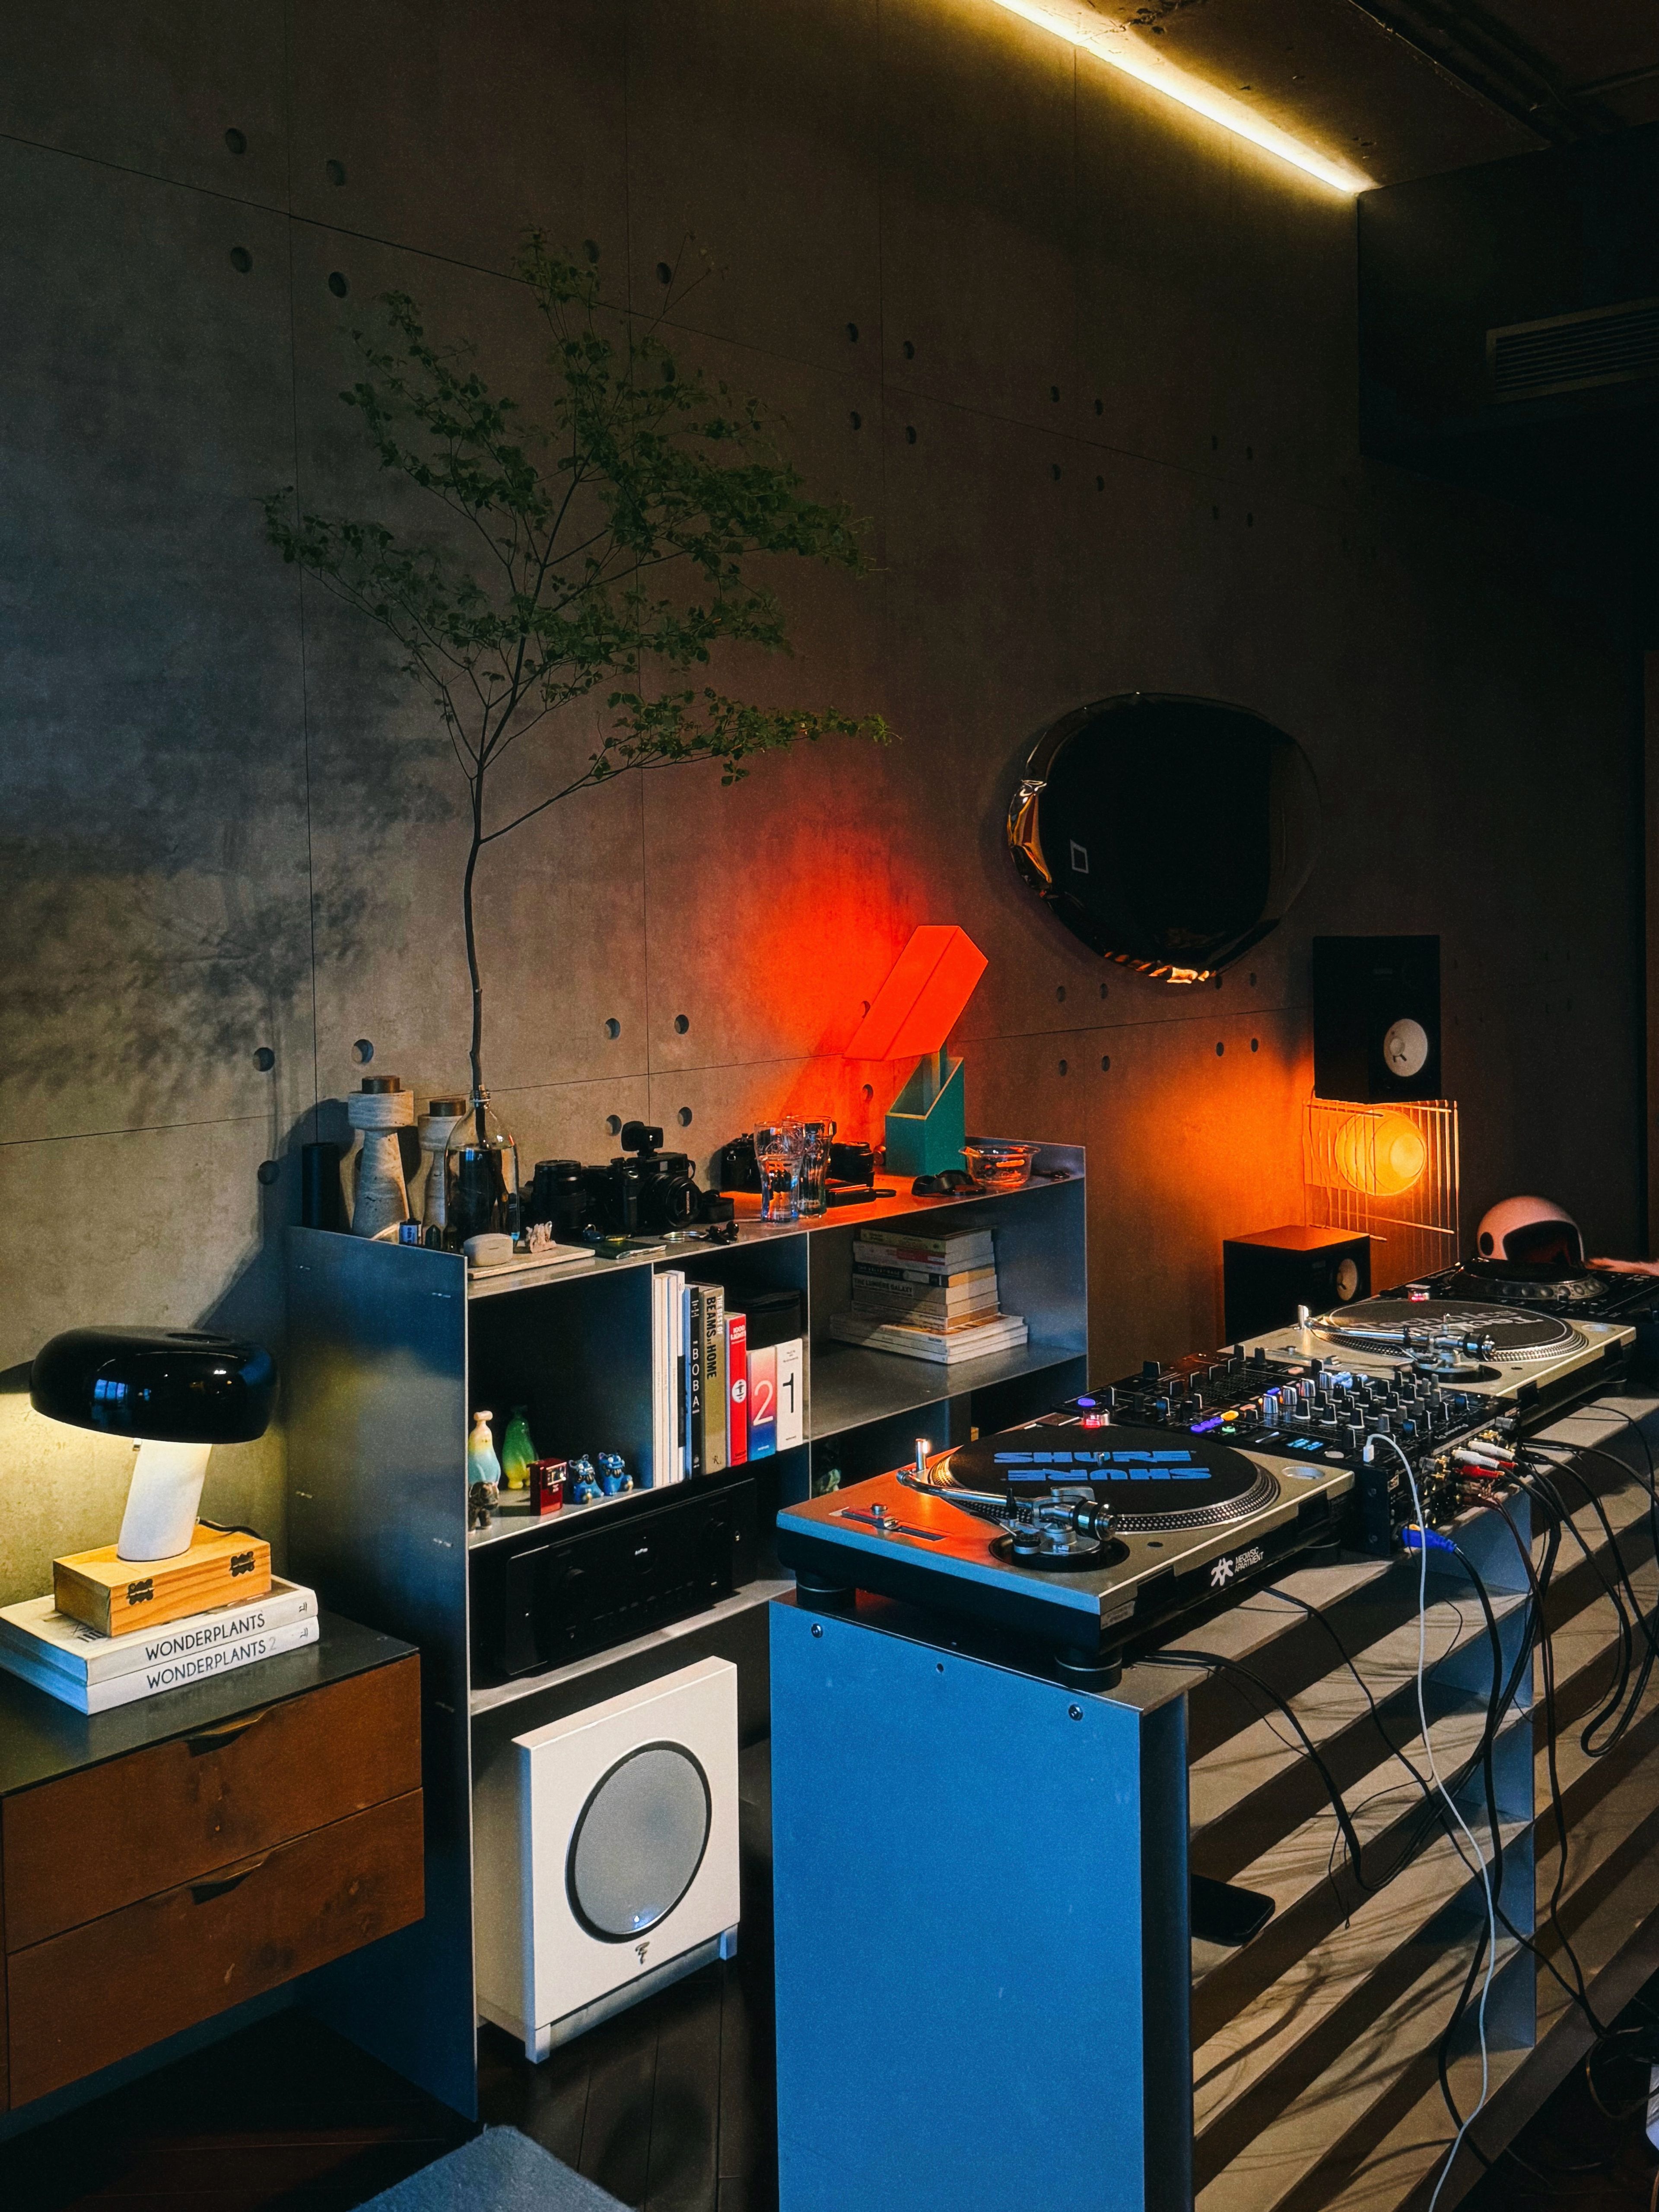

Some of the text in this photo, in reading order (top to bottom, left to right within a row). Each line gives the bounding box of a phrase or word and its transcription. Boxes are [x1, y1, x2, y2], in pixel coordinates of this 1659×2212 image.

[706, 1296, 716, 1338] BEAMS
[717, 1326, 723, 1335] OF
[707, 1344, 716, 1379] HOME
[753, 1380, 773, 1426] 2
[783, 1373, 794, 1413] 1
[994, 1450, 1192, 1463] SHURE
[1008, 1468, 1212, 1481] SHURE
[1235, 1551, 1264, 1573] APARTMENT
[1236, 1547, 1259, 1563] MEOWSIC
[146, 1613, 265, 1661] WONDERPLANTS
[147, 1636, 277, 1689] WONDERPLANTS 2
